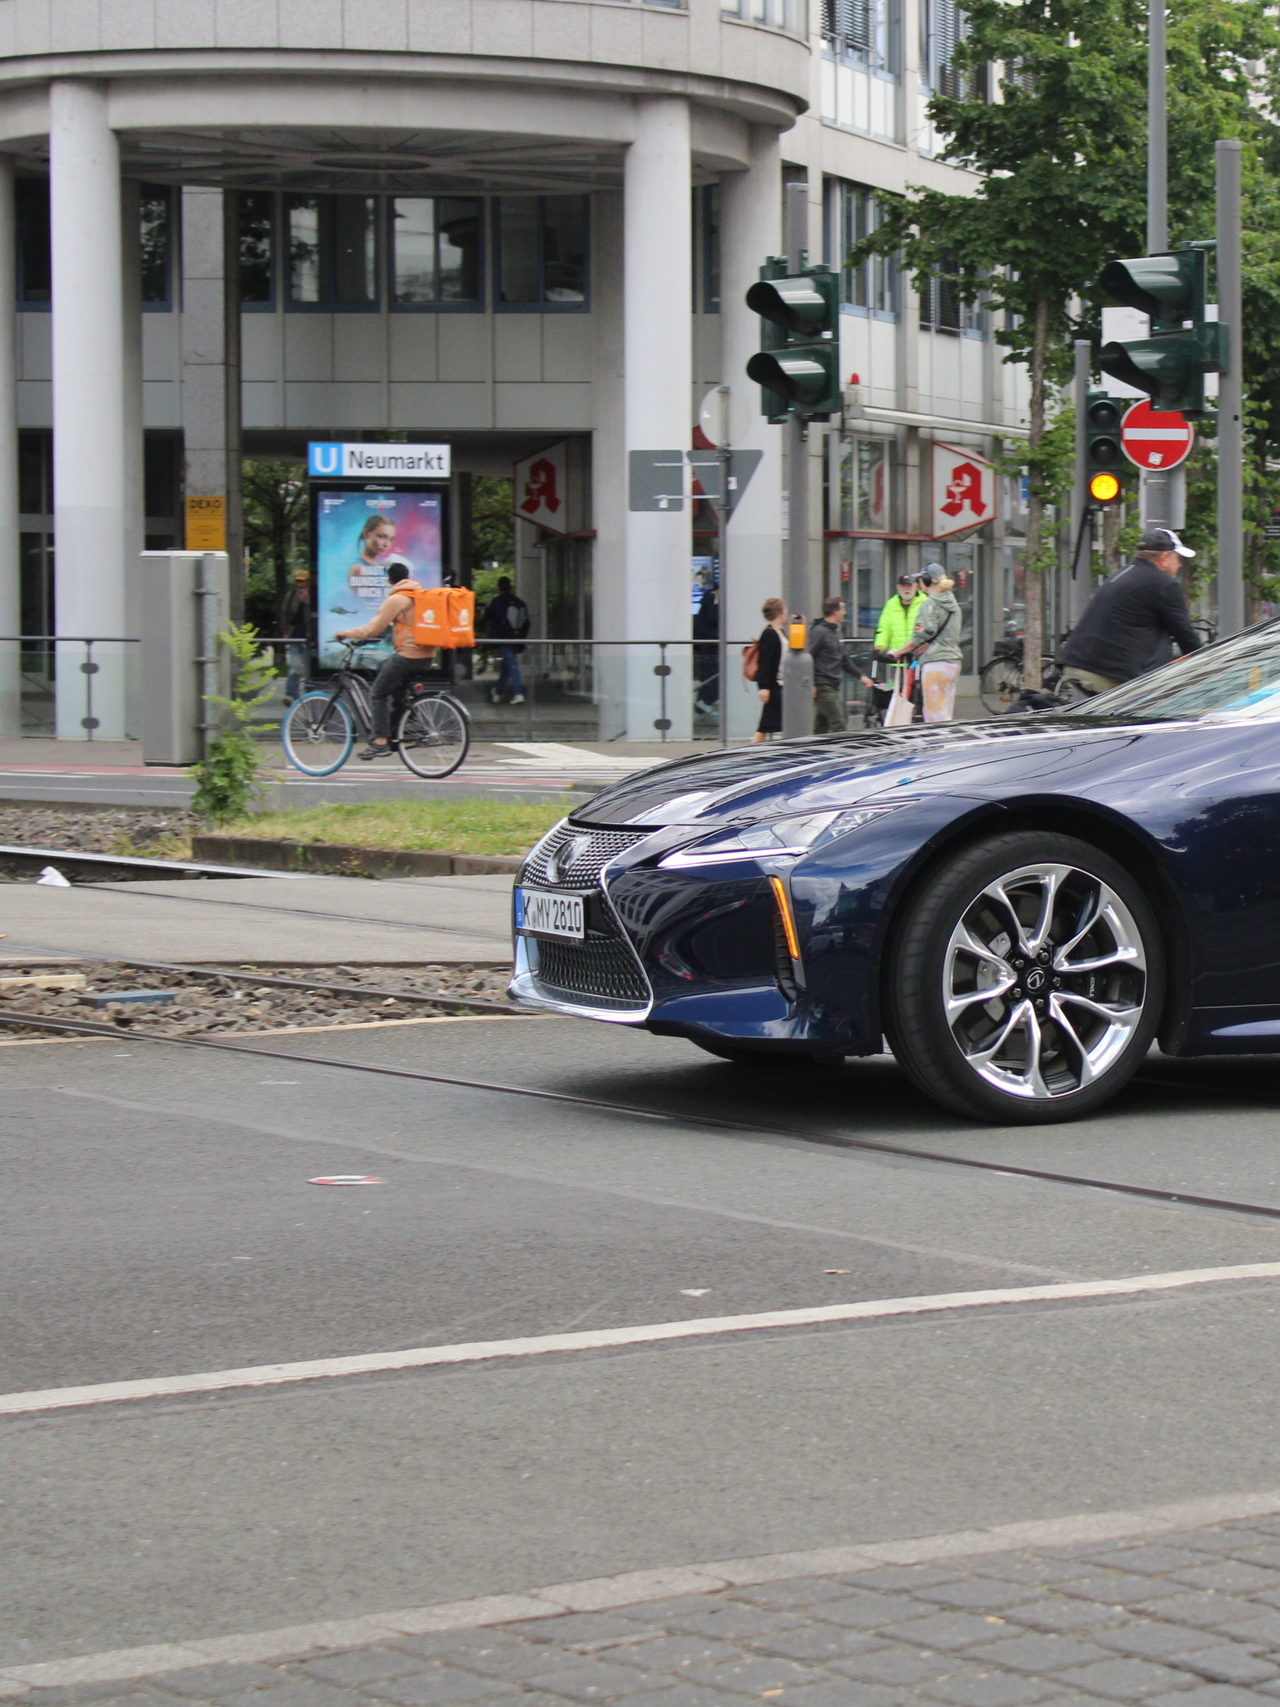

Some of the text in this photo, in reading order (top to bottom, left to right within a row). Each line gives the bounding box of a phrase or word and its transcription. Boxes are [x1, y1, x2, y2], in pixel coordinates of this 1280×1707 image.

[348, 451, 445, 470] Neumarkt
[522, 895, 582, 933] K MY 2810
